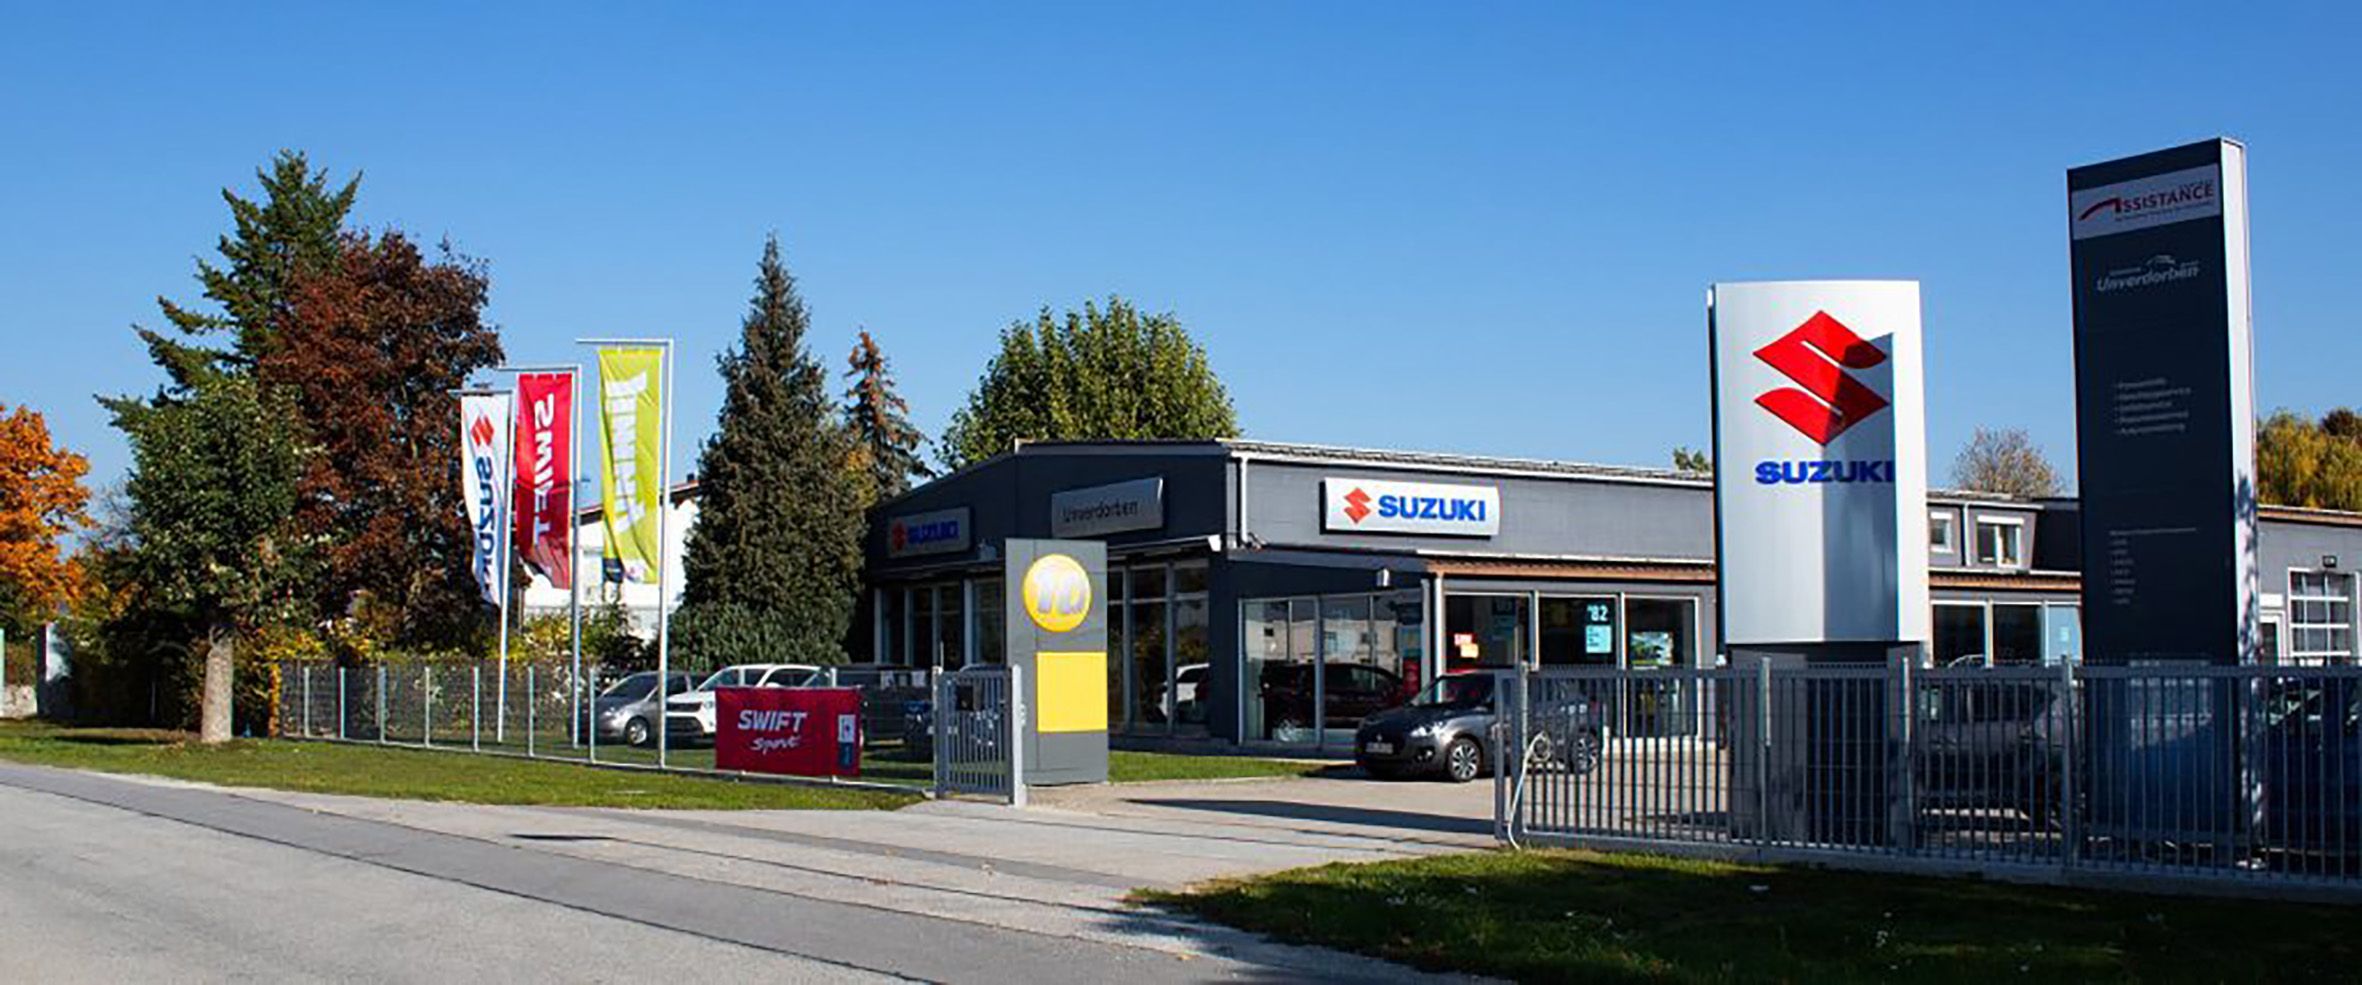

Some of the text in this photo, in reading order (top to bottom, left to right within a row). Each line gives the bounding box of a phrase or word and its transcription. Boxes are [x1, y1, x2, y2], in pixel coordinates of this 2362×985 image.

[1755, 460, 1895, 485] SUZUKI
[1378, 494, 1486, 521] SUZUKI
[738, 709, 808, 733] SWIFT
